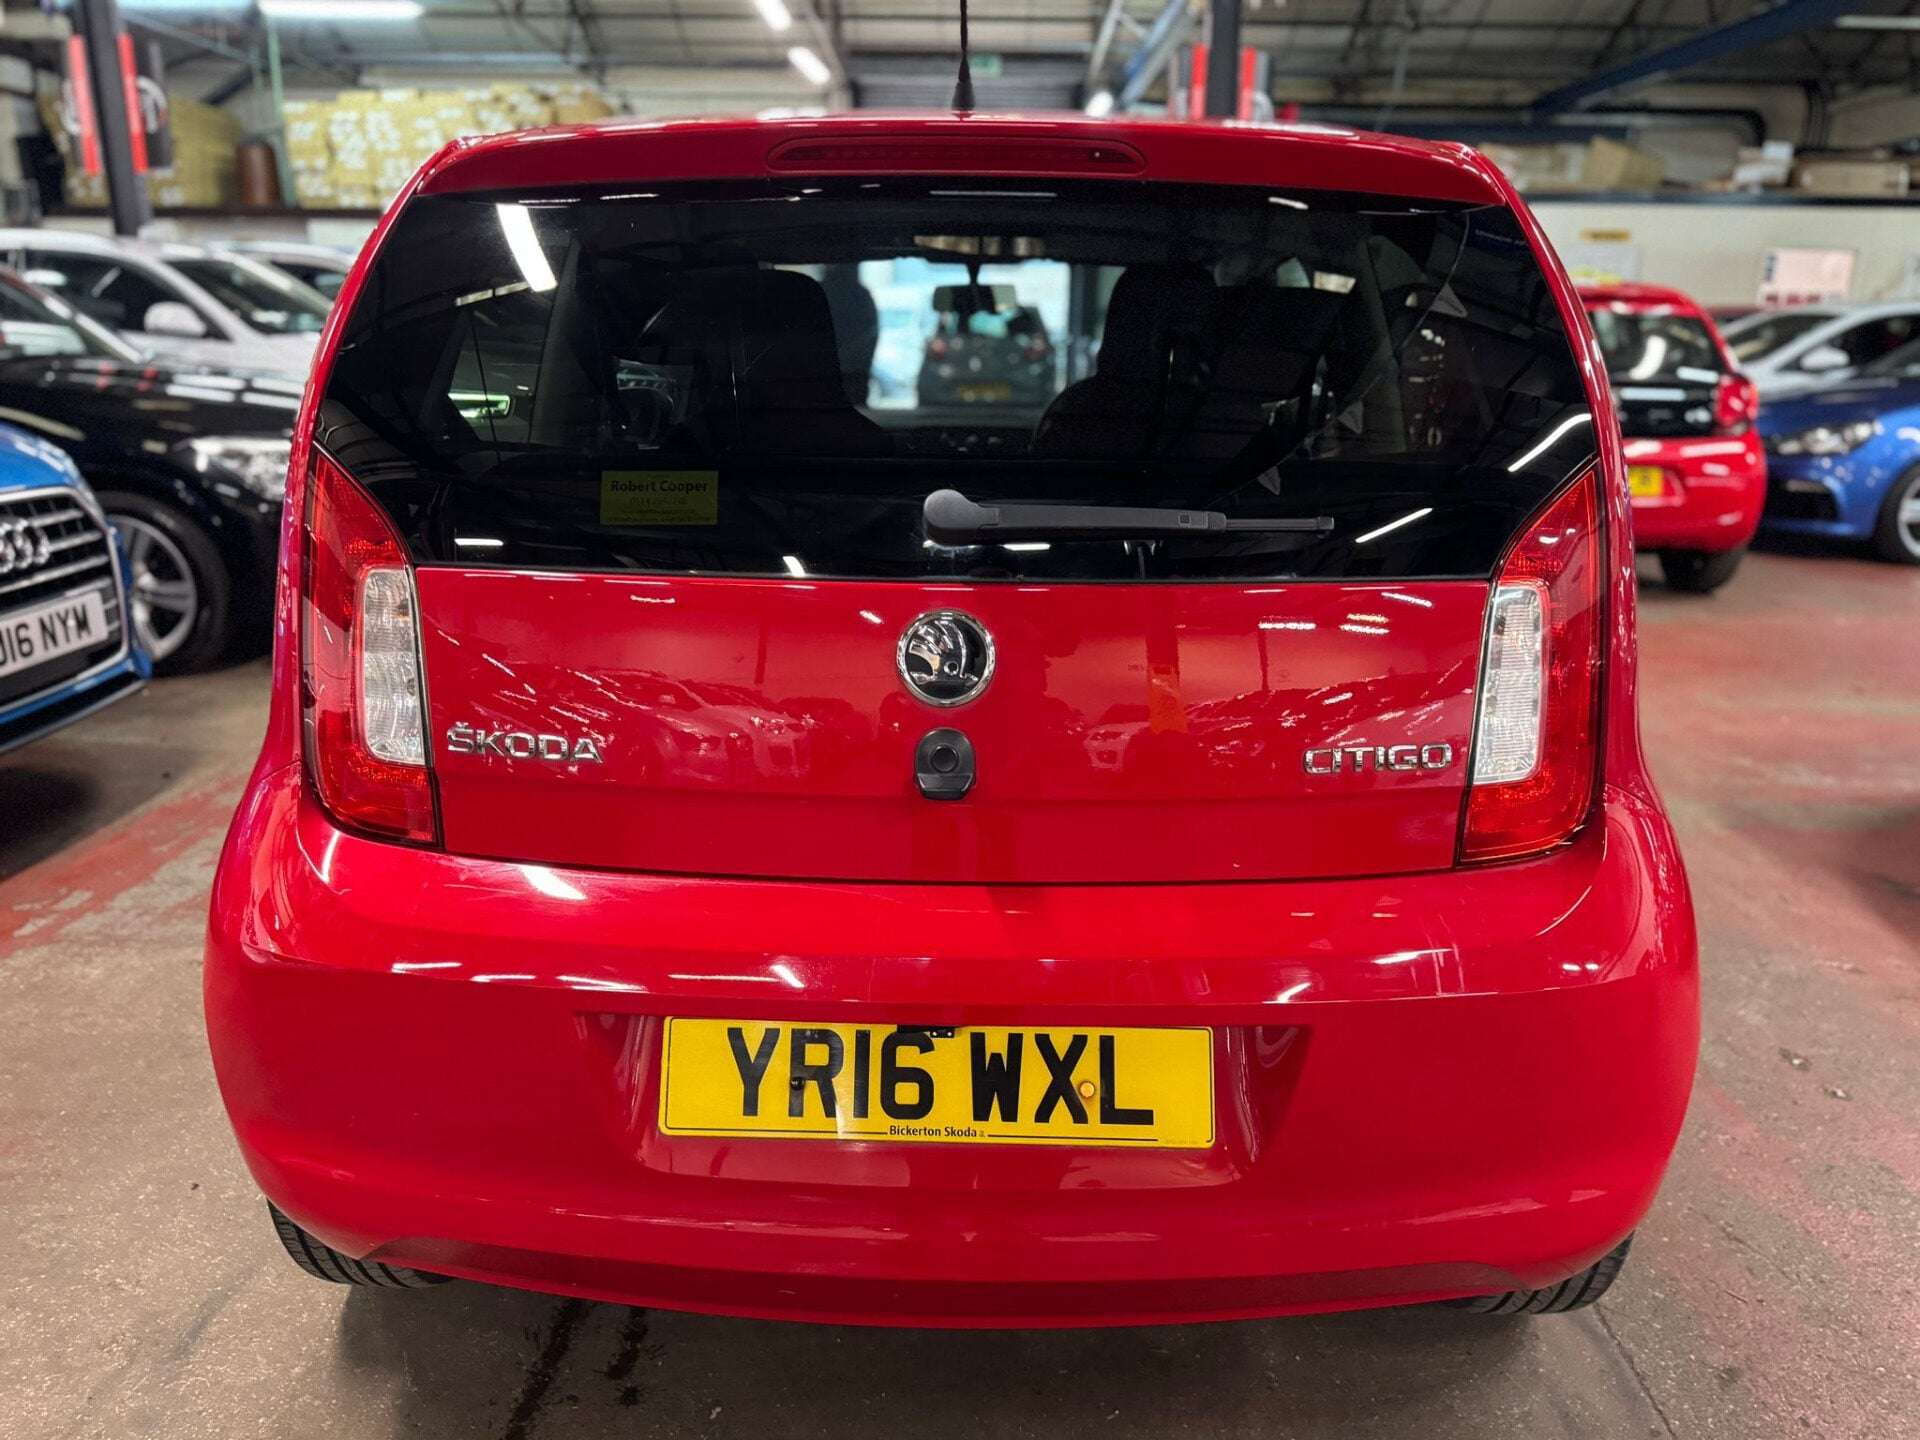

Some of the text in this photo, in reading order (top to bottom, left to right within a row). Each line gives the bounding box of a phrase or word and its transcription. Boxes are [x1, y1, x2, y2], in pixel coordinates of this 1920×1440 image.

[611, 480, 707, 495] Robert Cooper
[447, 721, 603, 764] ŠKODA
[1304, 744, 1452, 774] CITIGO
[727, 1026, 1154, 1126] YR16 WXL
[889, 1125, 941, 1137] Bickerton
[944, 1126, 977, 1138] Skoda
